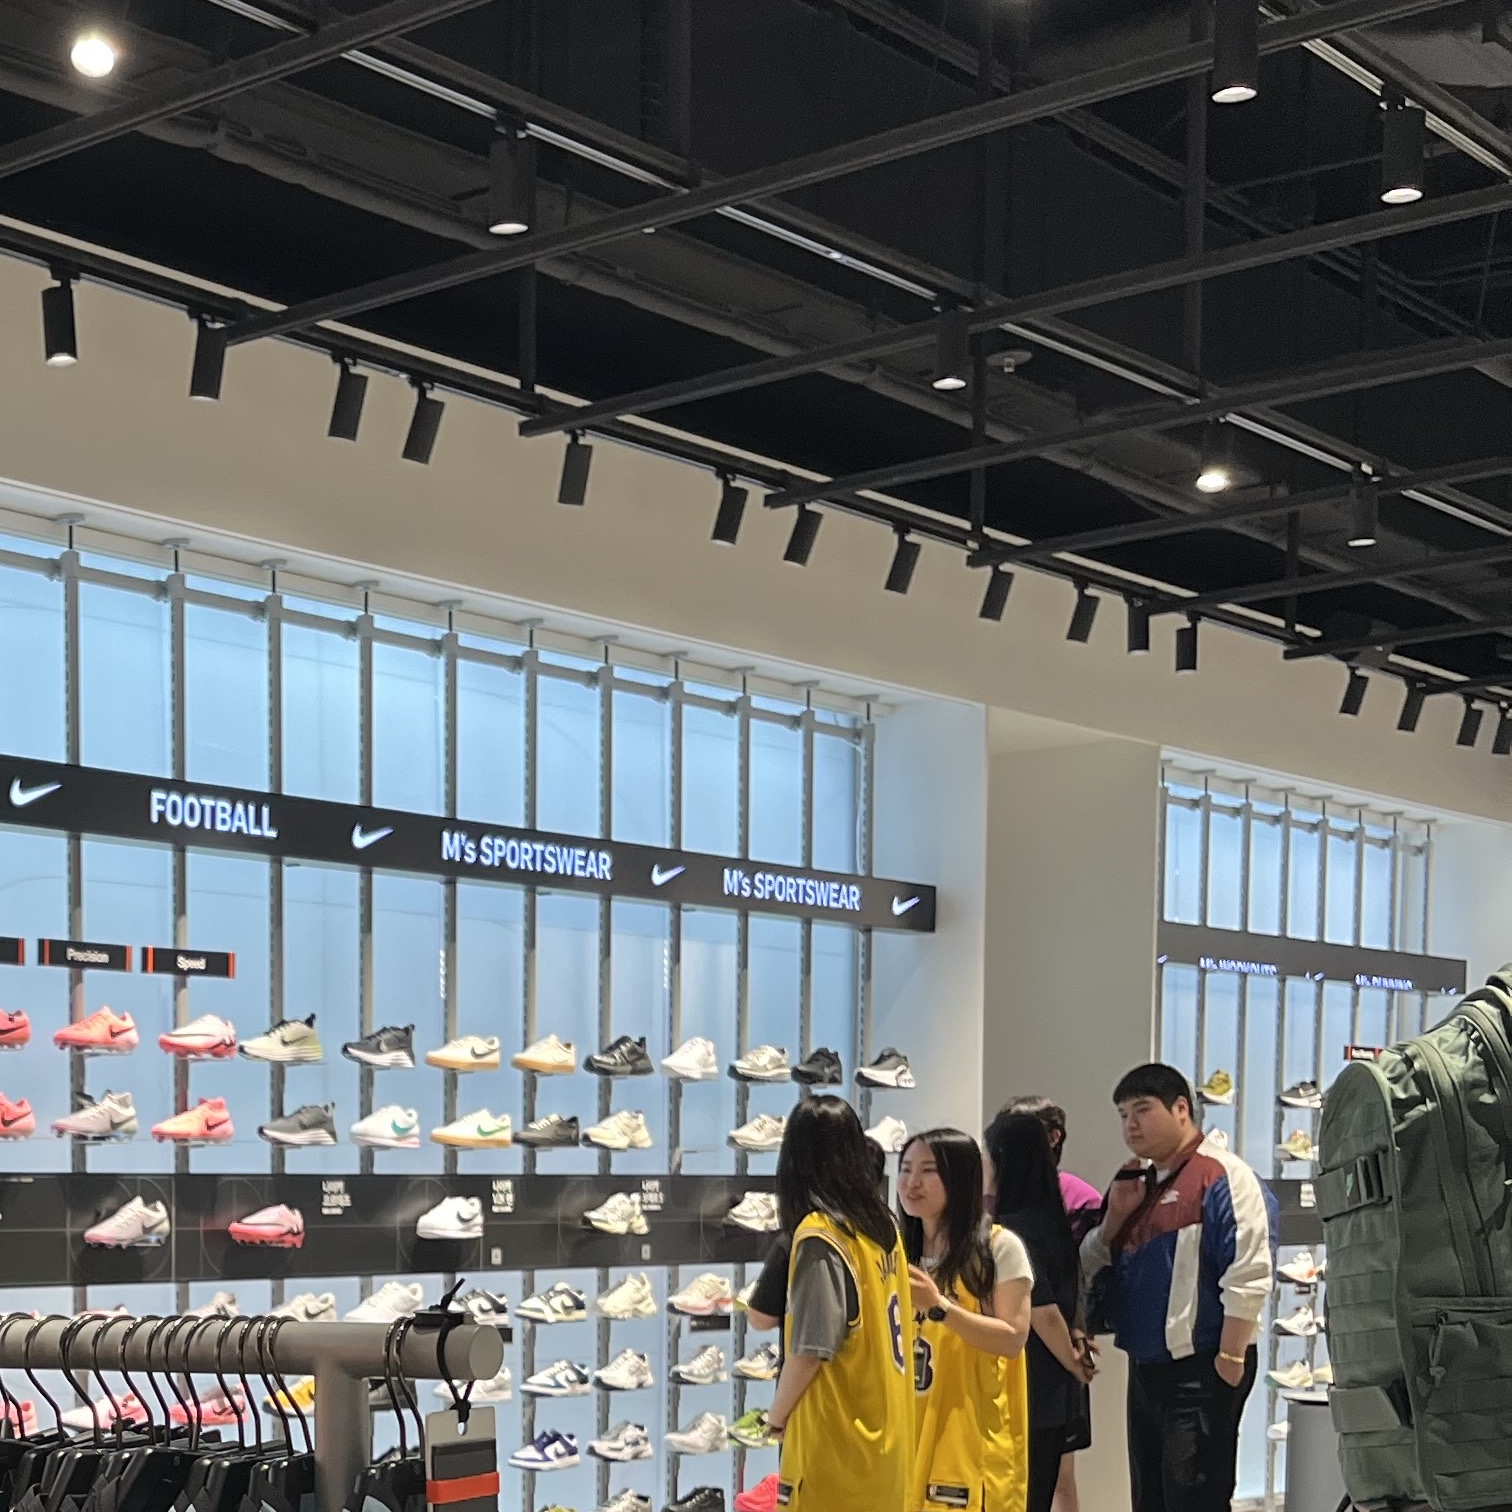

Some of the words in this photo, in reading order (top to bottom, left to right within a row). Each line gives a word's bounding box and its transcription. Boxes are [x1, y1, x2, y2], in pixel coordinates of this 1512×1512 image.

[149, 788, 279, 839] FOOTBALL
[441, 828, 477, 865] M's
[479, 833, 613, 881] SPORTSWEAR
[723, 867, 752, 898] M's
[753, 871, 862, 912] SPORTSWEAR
[65, 946, 111, 964] Precision
[175, 953, 207, 971] Speed
